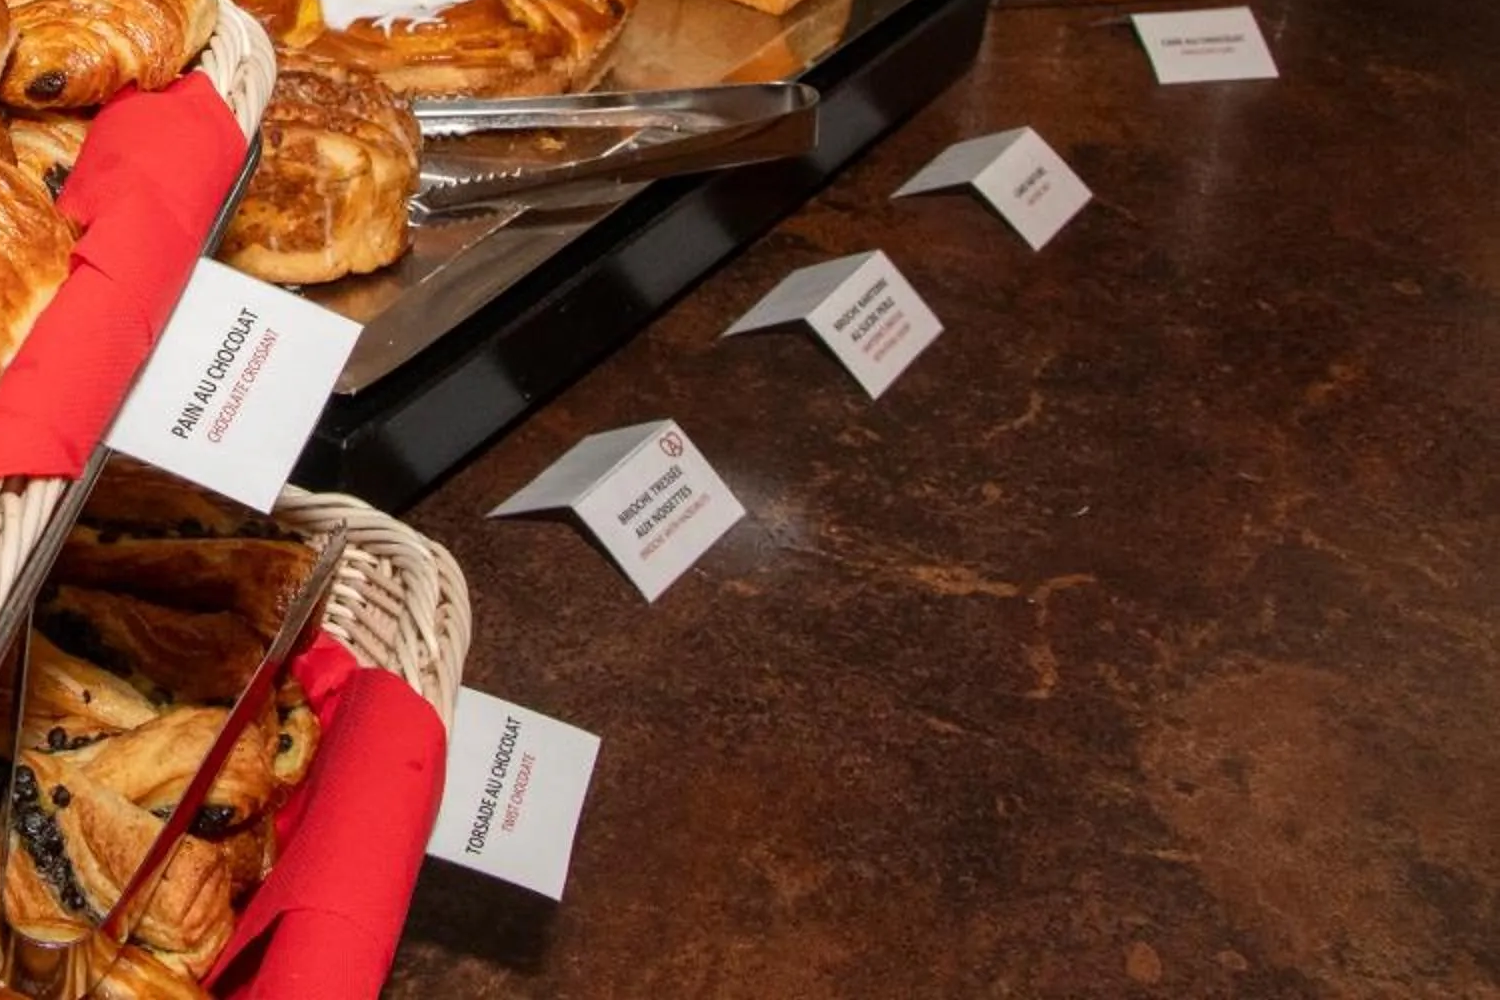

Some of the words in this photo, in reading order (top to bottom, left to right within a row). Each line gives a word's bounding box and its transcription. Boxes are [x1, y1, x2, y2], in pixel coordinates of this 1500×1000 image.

[171, 402, 204, 439] PAIN
[194, 379, 217, 404] AU
[207, 307, 258, 380] CHOCOLAT
[207, 381, 249, 443] CHOCOLATE
[241, 328, 279, 383] CROISSANT
[492, 715, 521, 778] CHOCOLAT
[485, 778, 503, 799] AU
[465, 798, 497, 855] TORSADE
